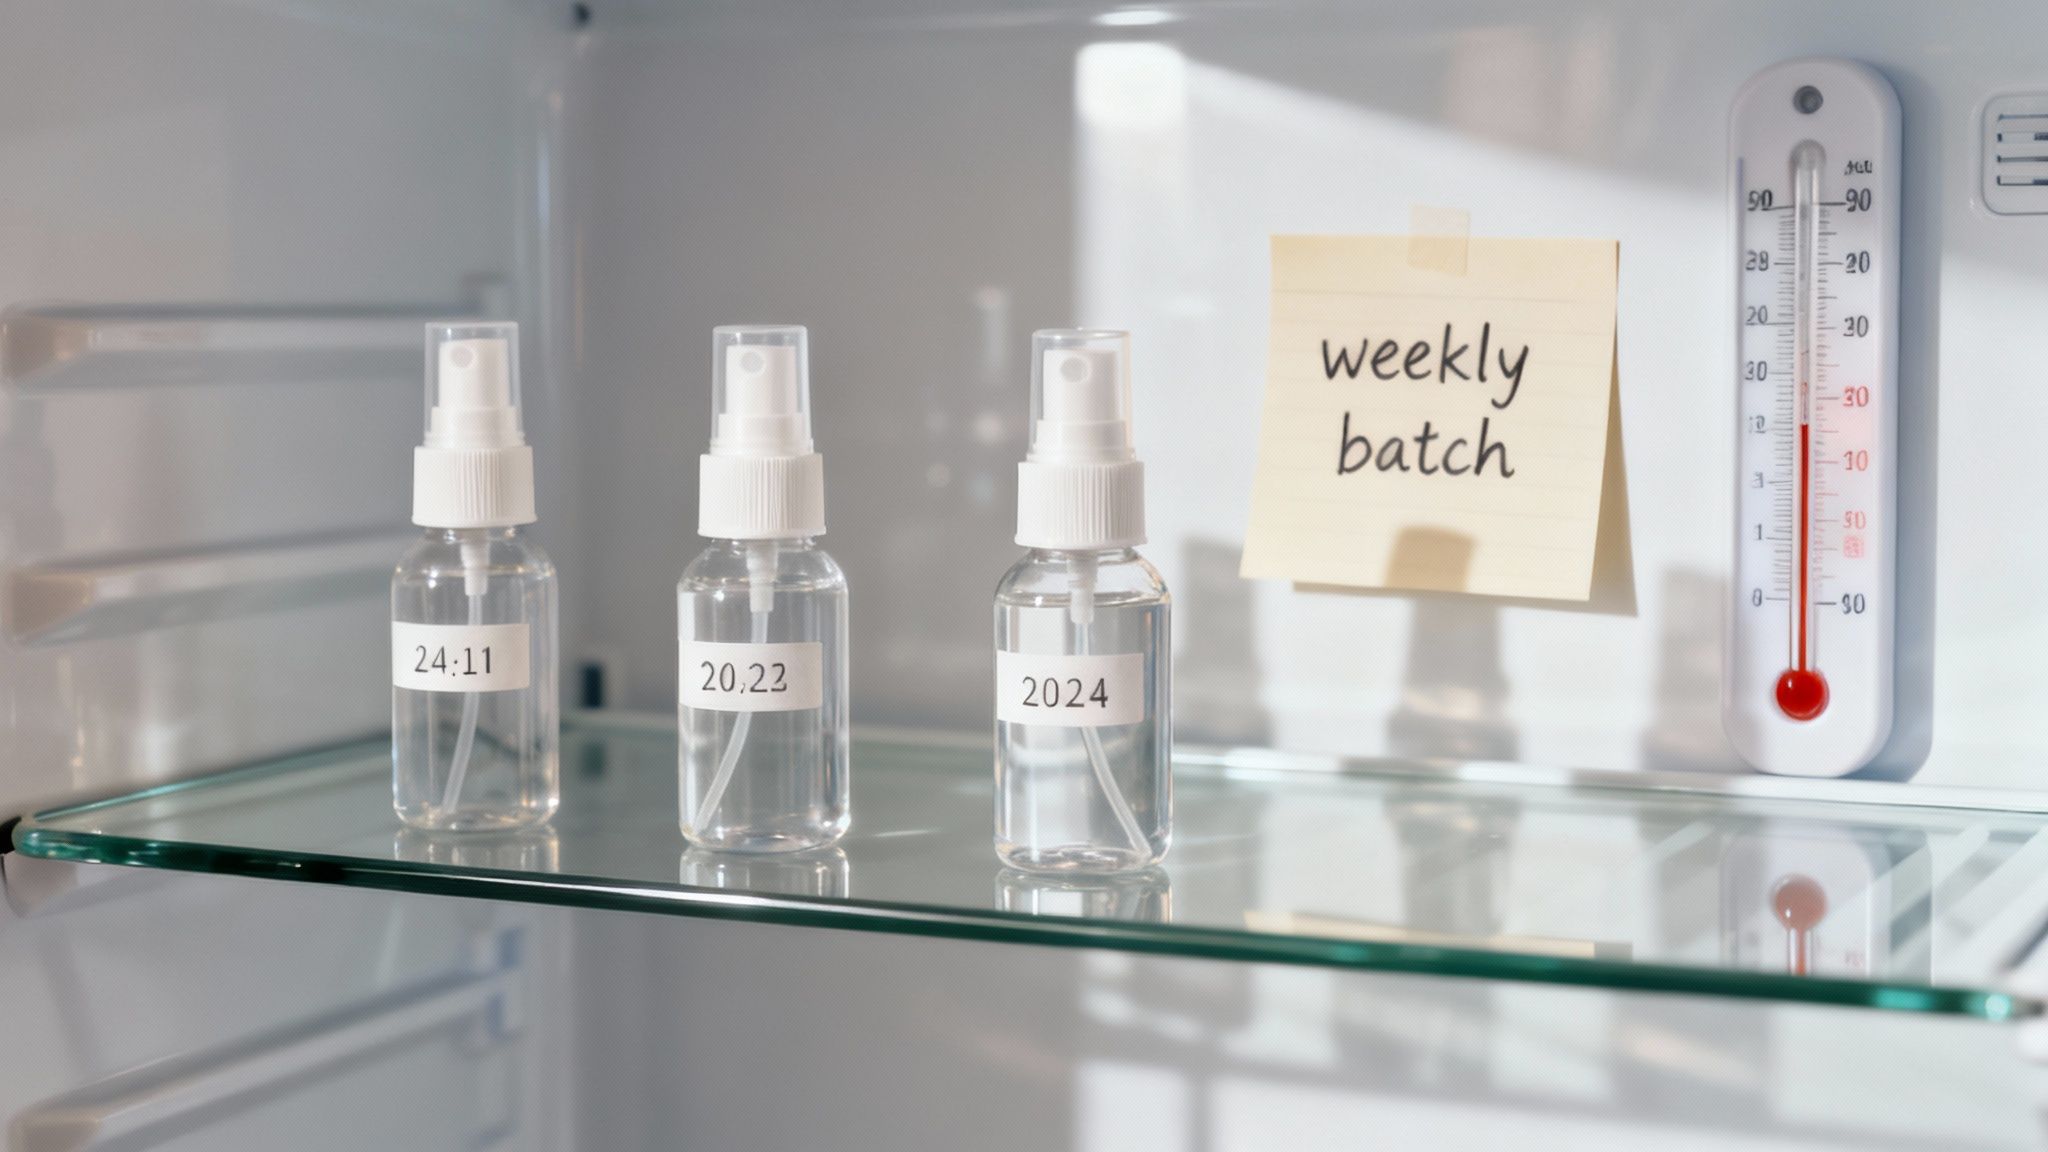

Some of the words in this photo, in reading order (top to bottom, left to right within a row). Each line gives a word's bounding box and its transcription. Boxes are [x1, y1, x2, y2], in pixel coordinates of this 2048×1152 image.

[1322, 322, 1529, 409] weekly
[1337, 411, 1515, 479] batch
[414, 644, 492, 677] 24:11
[1022, 676, 1109, 708] 2024
